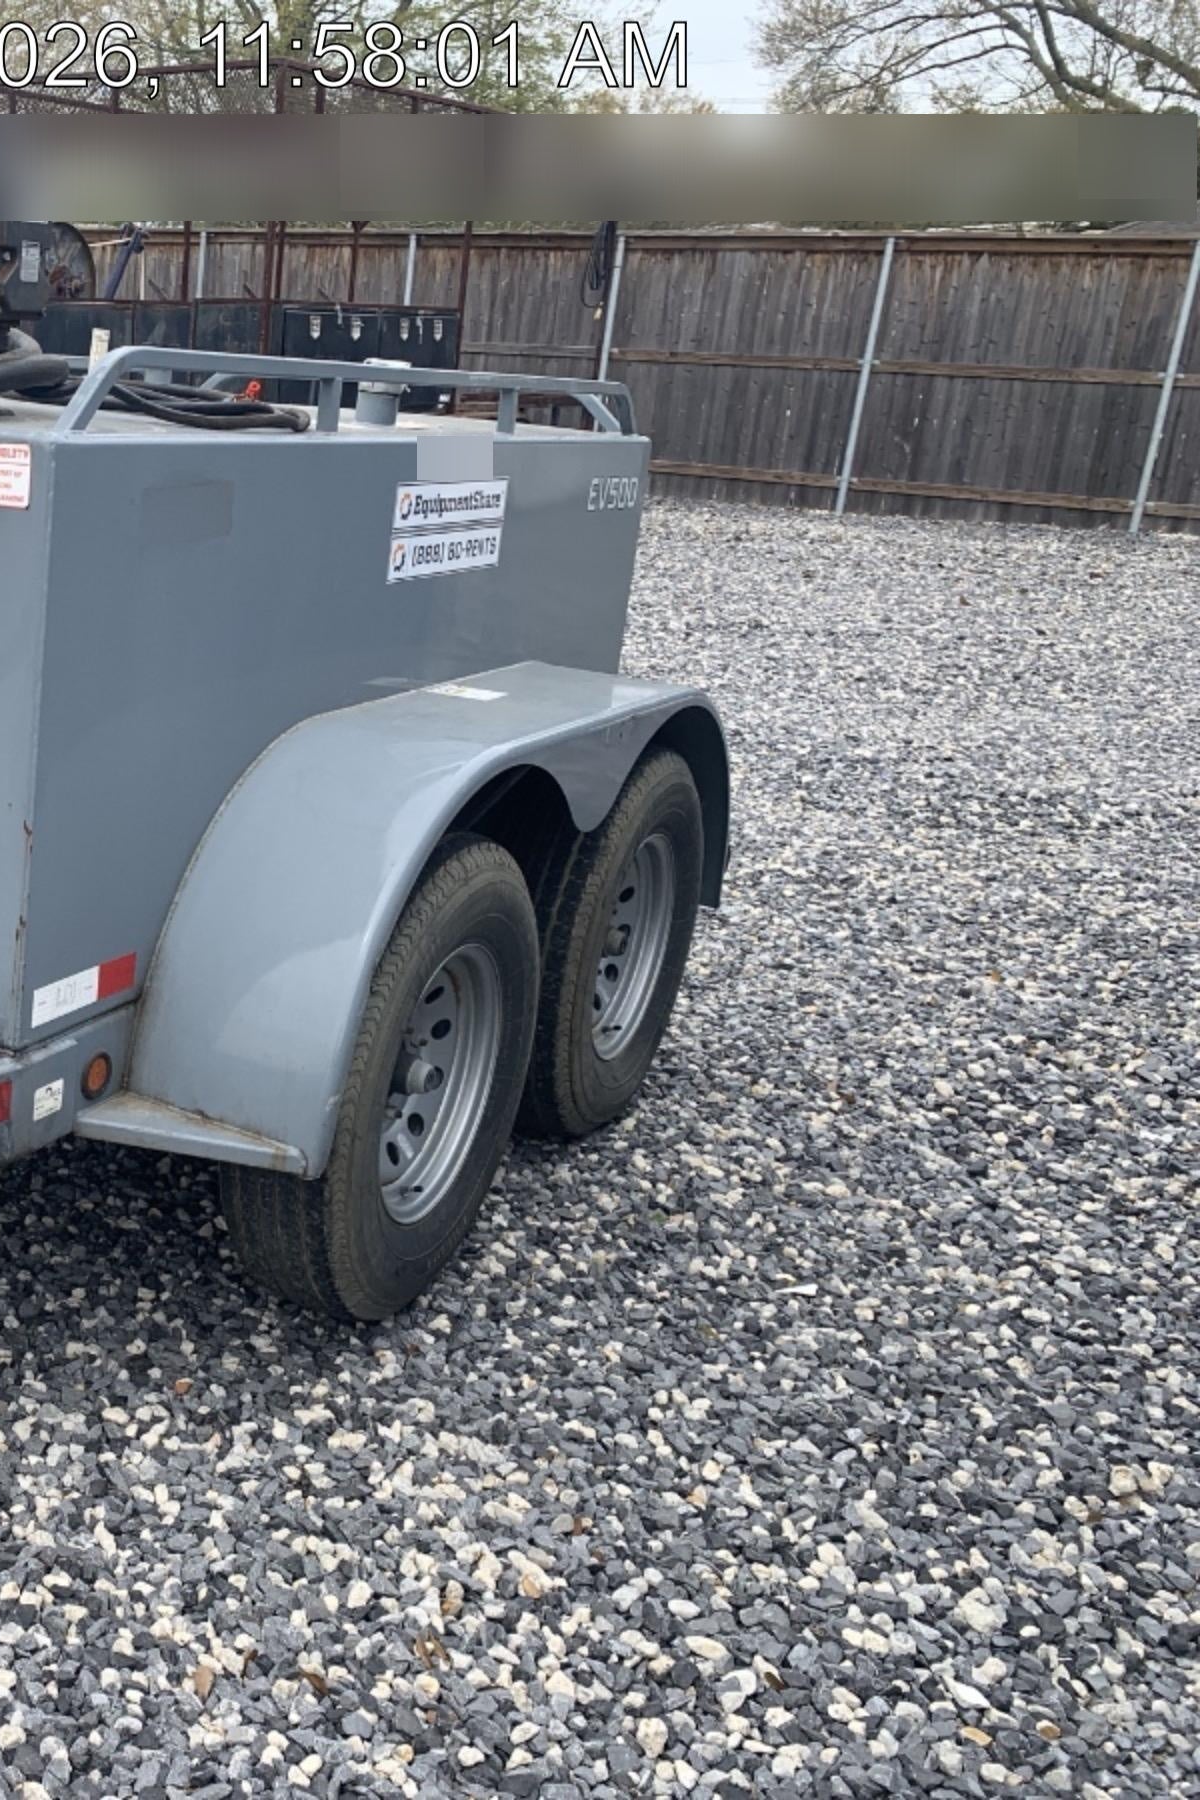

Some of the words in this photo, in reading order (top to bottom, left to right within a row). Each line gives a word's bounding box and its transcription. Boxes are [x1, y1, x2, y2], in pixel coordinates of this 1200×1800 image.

[413, 490, 501, 519] EquipmentShare
[587, 477, 639, 512] EV500
[411, 544, 444, 568] (888)
